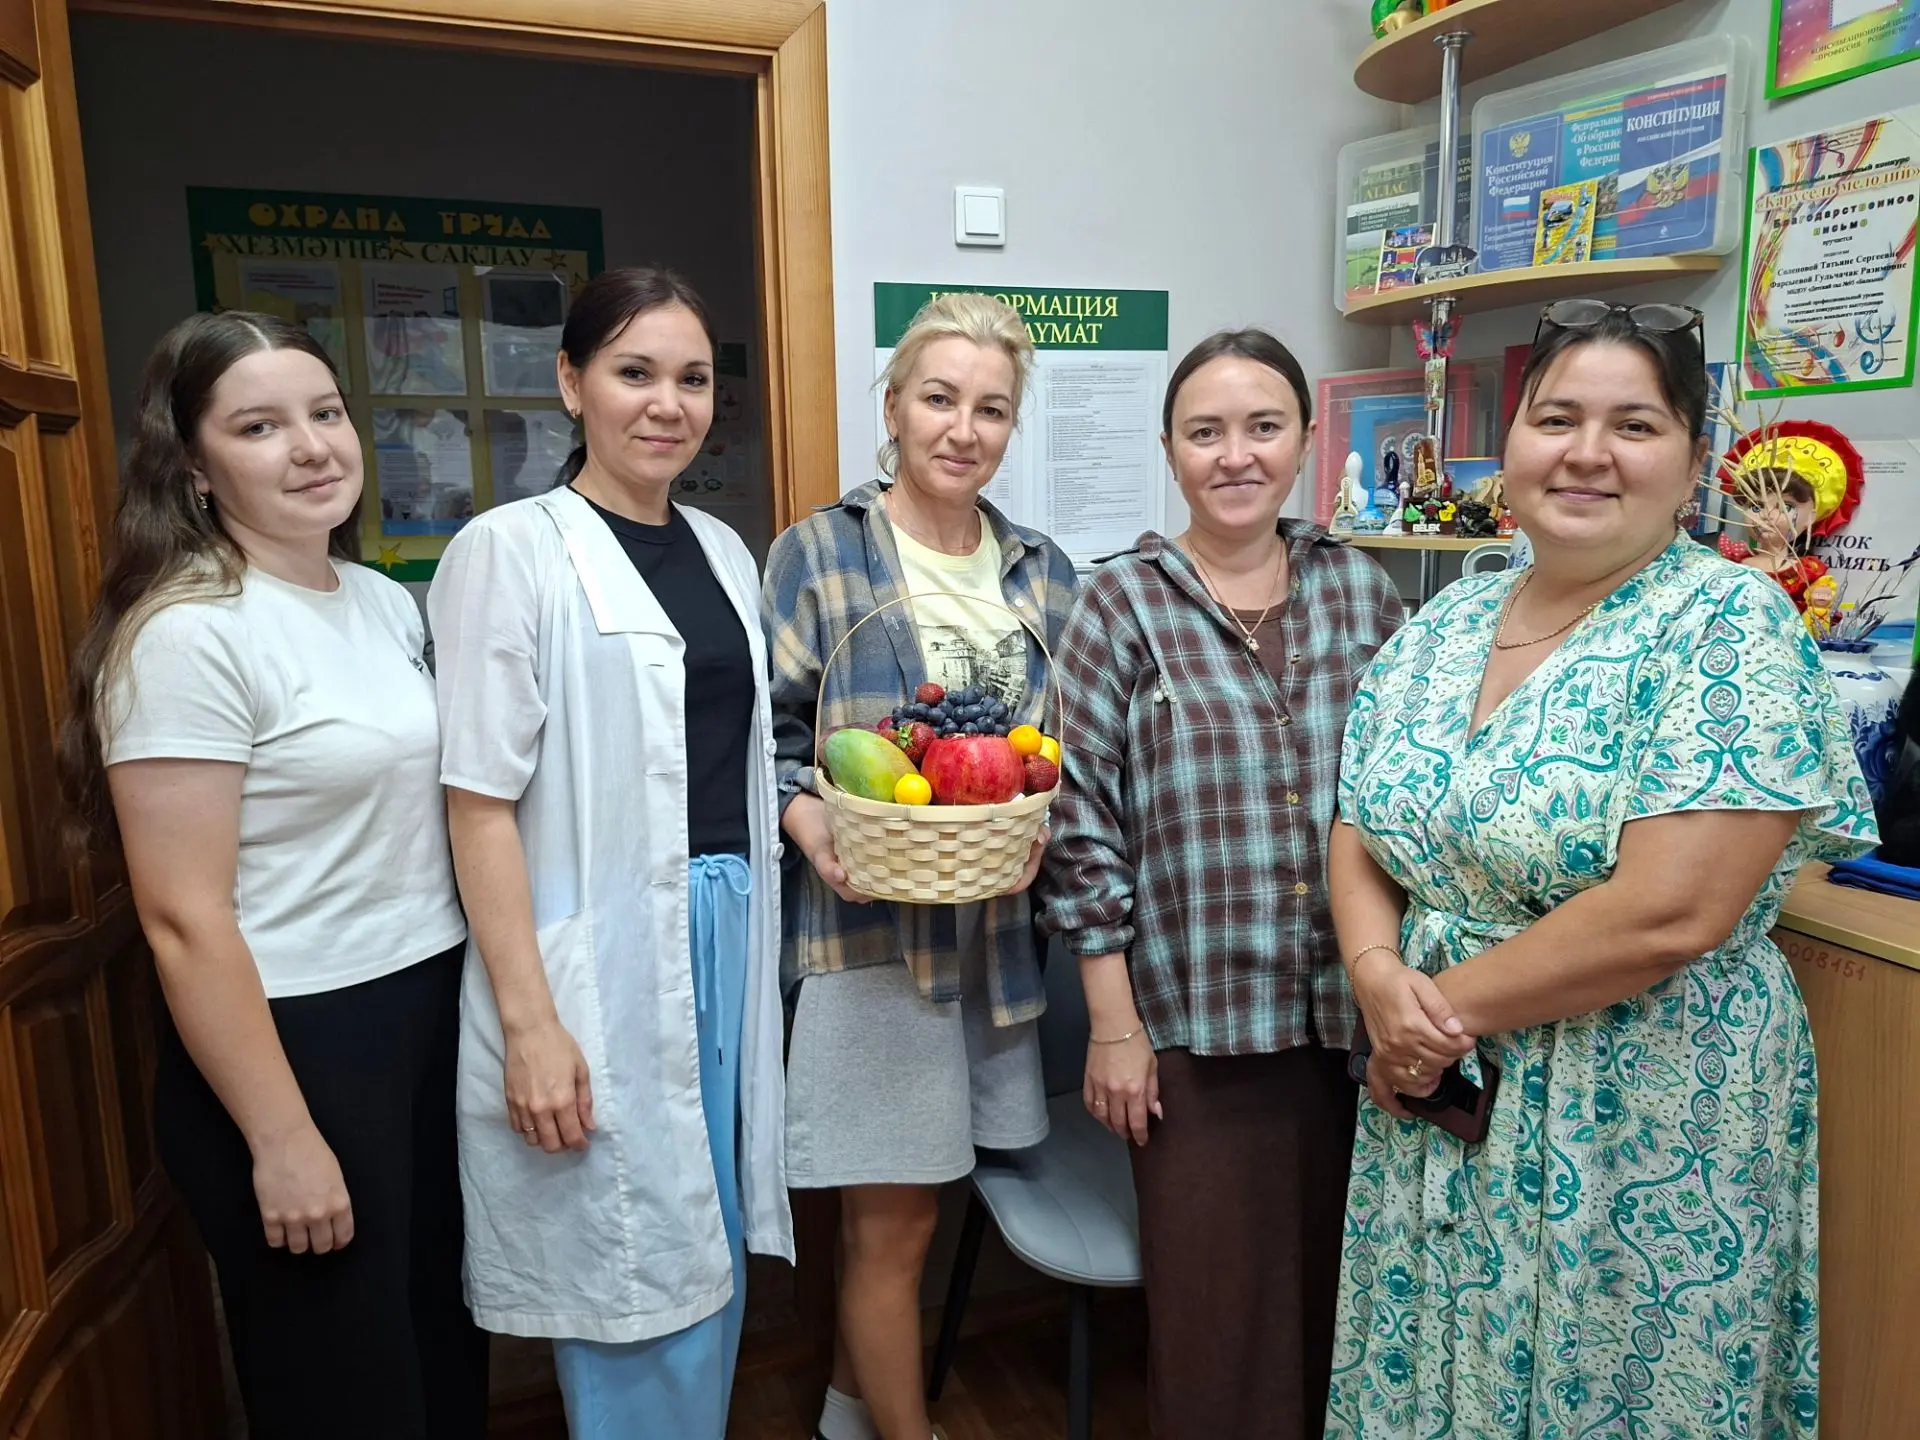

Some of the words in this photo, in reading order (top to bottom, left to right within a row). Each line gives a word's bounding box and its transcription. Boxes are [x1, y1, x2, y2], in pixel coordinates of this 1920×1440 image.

[1571, 115, 1623, 133] Федеральны
[1626, 100, 1720, 133] КОНСТИТУЦИЯ
[1587, 127, 1623, 142] образо
[1584, 140, 1621, 155] Российс
[1485, 156, 1553, 177] Конституция
[1580, 153, 1620, 168] Федерац
[1875, 156, 1911, 169] конкурс
[1488, 166, 1549, 187] Российской
[1489, 180, 1546, 197] Федерации
[1773, 194, 1915, 229] Благодарственное
[248, 202, 407, 232] ОХРАНА
[437, 211, 553, 239] ТРУДА
[1813, 219, 1868, 236] письмо
[1822, 236, 1853, 247] вручается
[421, 243, 535, 268] САКЛАУ
[1820, 257, 1853, 270] Татьяне
[1412, 523, 1441, 532] BELEK
[1816, 535, 1872, 550] ЕЛОК
